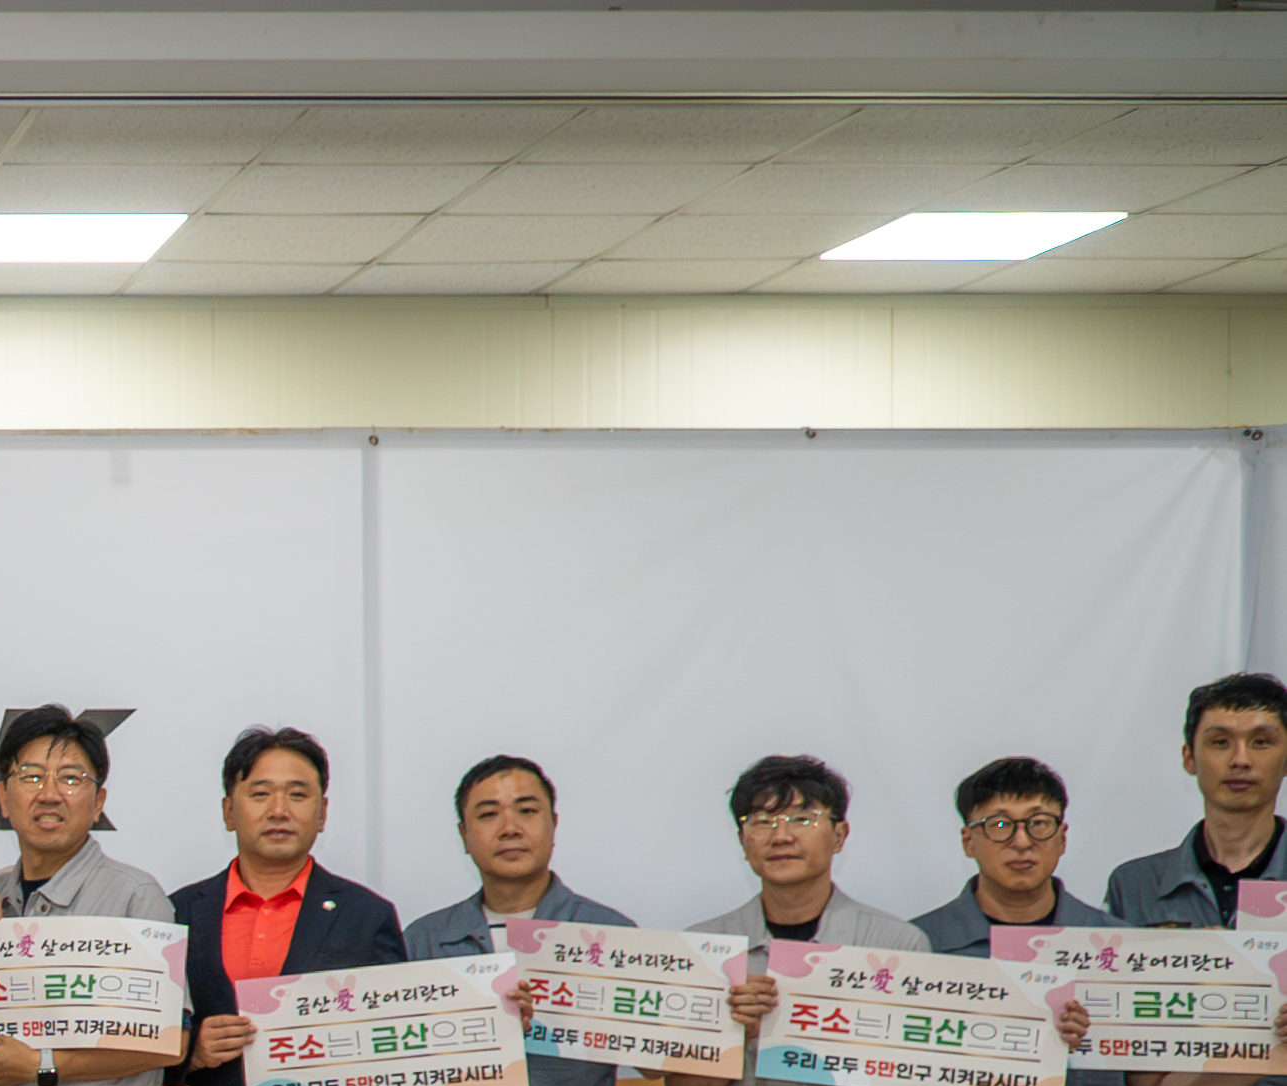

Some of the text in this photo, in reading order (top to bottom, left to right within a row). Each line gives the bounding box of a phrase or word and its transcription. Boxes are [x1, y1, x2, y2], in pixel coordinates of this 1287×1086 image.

[40, 939, 131, 956] 살어리랏다
[609, 949, 694, 972] 살어리랏다
[1126, 953, 1234, 972] 살어리랏다
[43, 974, 160, 1005] 금산으로!
[362, 984, 459, 1009] 살어리랏다
[529, 978, 720, 1024] 주소는! 금산으로!
[901, 976, 1009, 1001] 살어리랏다
[1083, 990, 1268, 1020] 는! 금산으로!
[22, 1020, 69, 1038] 5만인구
[74, 1020, 160, 1040] 지켜갑시다!
[268, 1017, 495, 1063] 주소는! 금산으로!
[788, 1003, 1039, 1054] 주소는! 금산으로!
[551, 1027, 579, 1046] 모두
[583, 1031, 635, 1053] 5만인구
[640, 1037, 720, 1063] 지켜갑시다!
[1069, 1038, 1270, 1060] 두 5만인구 지켜갑시다!
[412, 1063, 503, 1086] 지켜갑시다!
[783, 1050, 817, 1070] 우리
[823, 1055, 859, 1074] 모두
[864, 1059, 931, 1082] 5만인구
